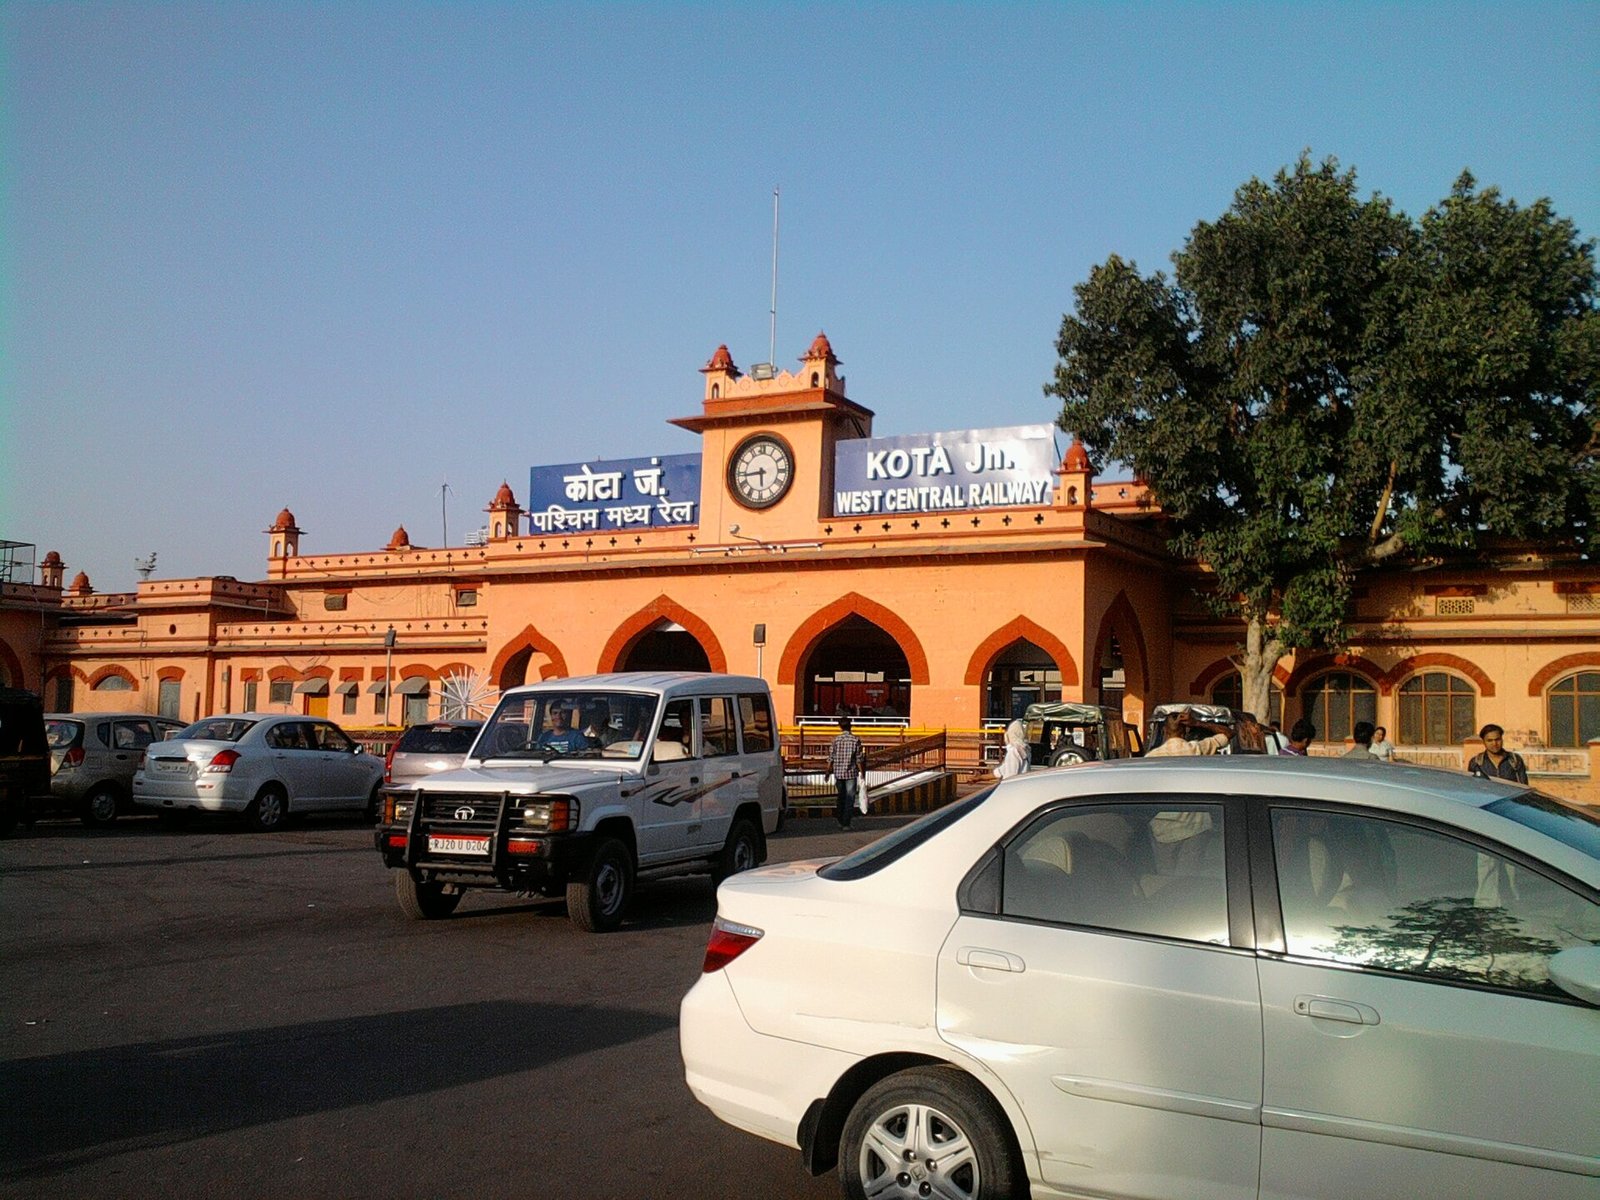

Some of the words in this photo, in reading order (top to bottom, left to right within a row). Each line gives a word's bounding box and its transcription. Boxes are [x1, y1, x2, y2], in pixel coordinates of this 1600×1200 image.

[563, 464, 622, 501] कोटा
[634, 457, 665, 496] जं.
[866, 444, 952, 479] KOTA
[531, 504, 599, 531] पश्चिम
[605, 505, 651, 526] मध्य
[656, 496, 694, 522] रेल
[837, 489, 882, 513] WEST
[885, 484, 964, 511] CENTRAL
[969, 480, 1048, 505] RAILWAY
[434, 839, 456, 850] RJ20
